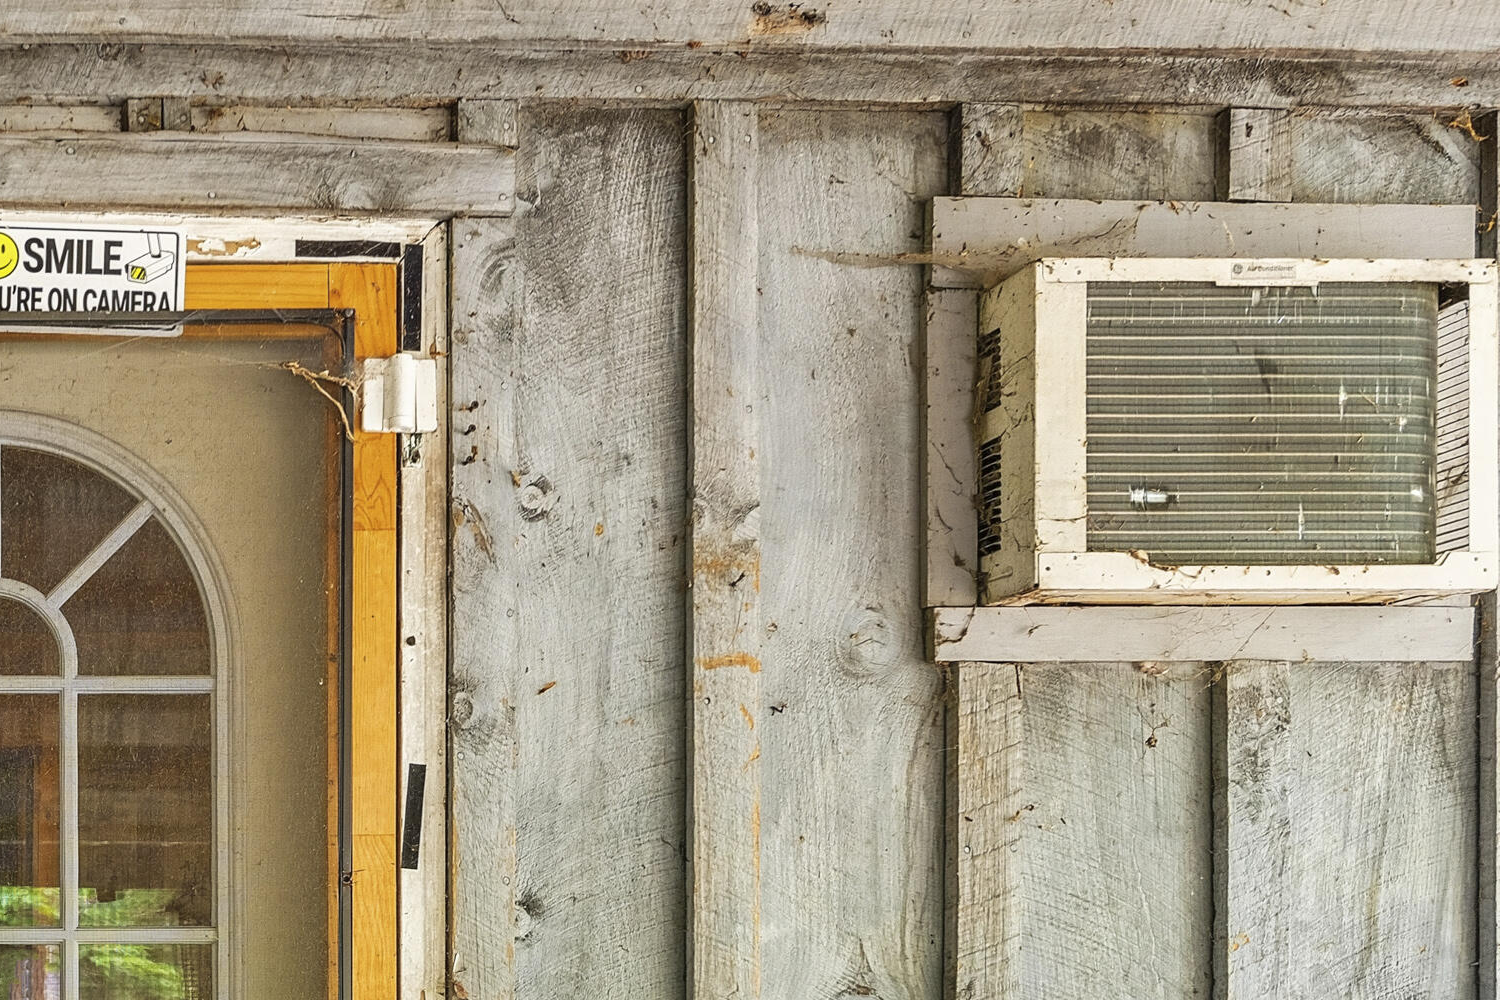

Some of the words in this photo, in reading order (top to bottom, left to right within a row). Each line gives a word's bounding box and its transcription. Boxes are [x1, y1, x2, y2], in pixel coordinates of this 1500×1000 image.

[22, 236, 124, 276] SMILE
[48, 287, 78, 312] ON
[82, 288, 171, 312] CAMERA
